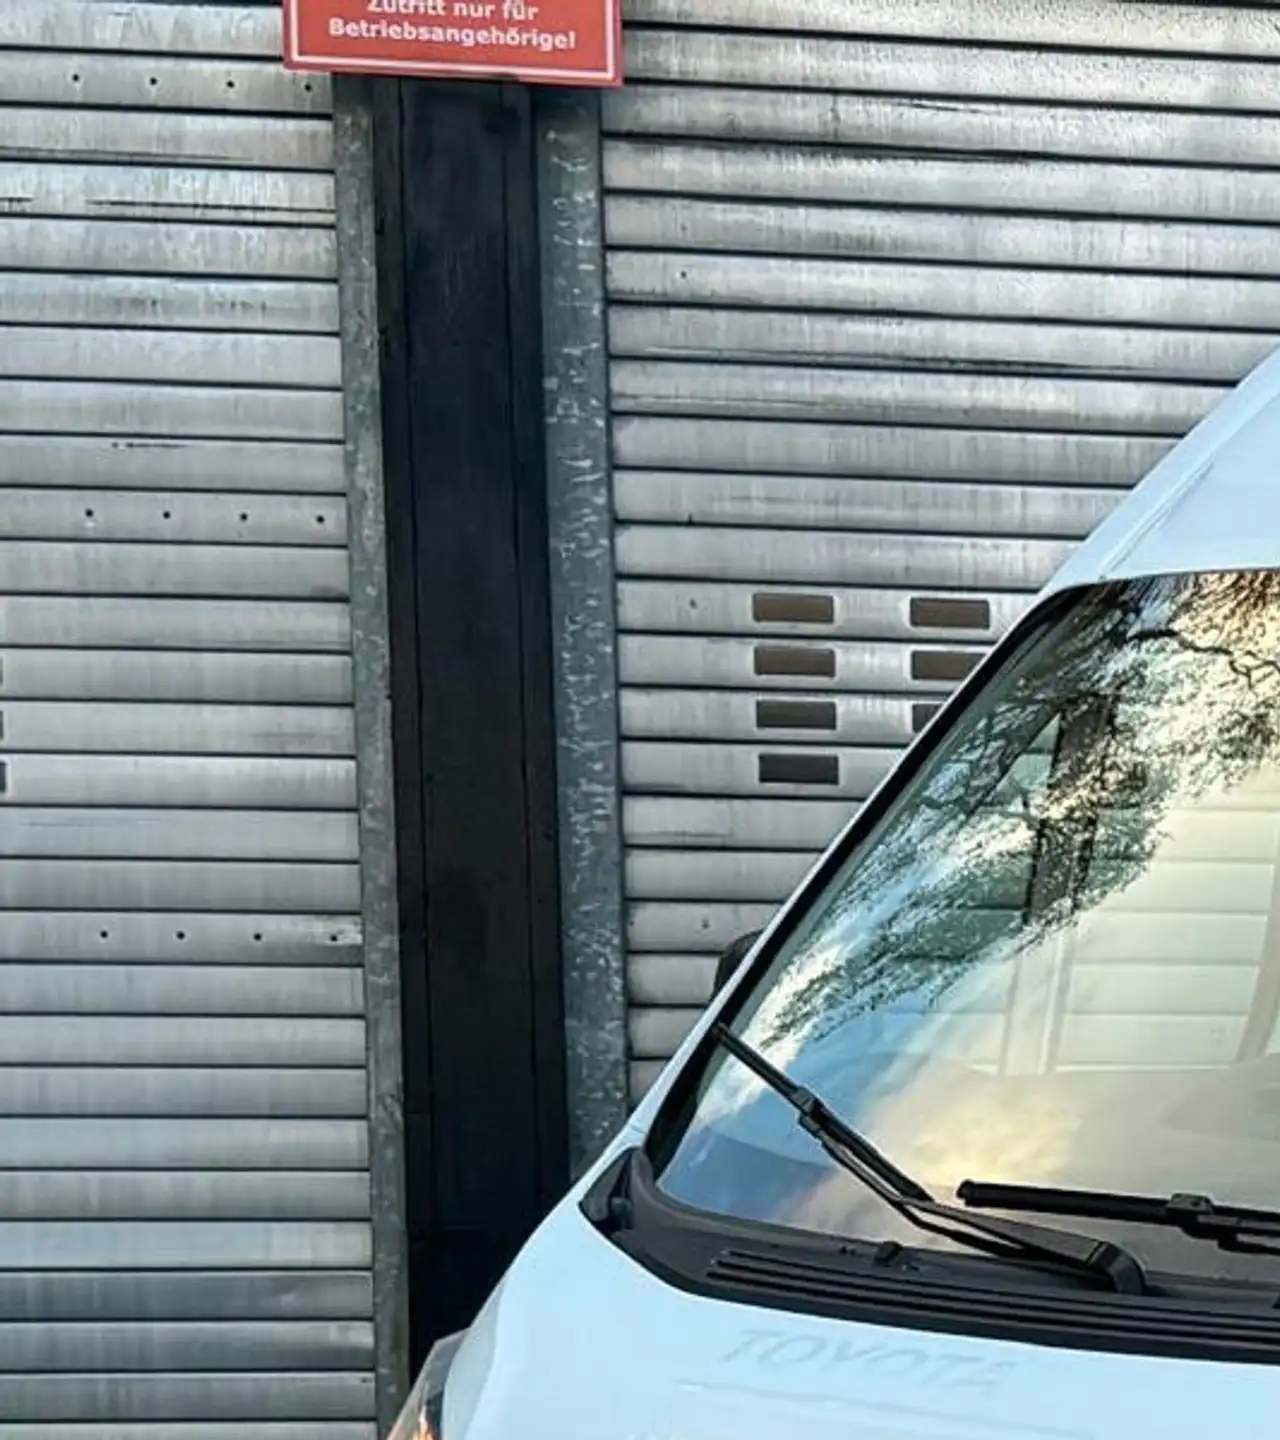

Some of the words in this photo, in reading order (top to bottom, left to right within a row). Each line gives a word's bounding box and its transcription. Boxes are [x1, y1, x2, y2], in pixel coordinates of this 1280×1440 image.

[367, 0, 445, 15] Zutritt
[453, 1, 496, 19] nur
[502, 0, 539, 21] für
[329, 17, 576, 51] Betriebsangehörige!
